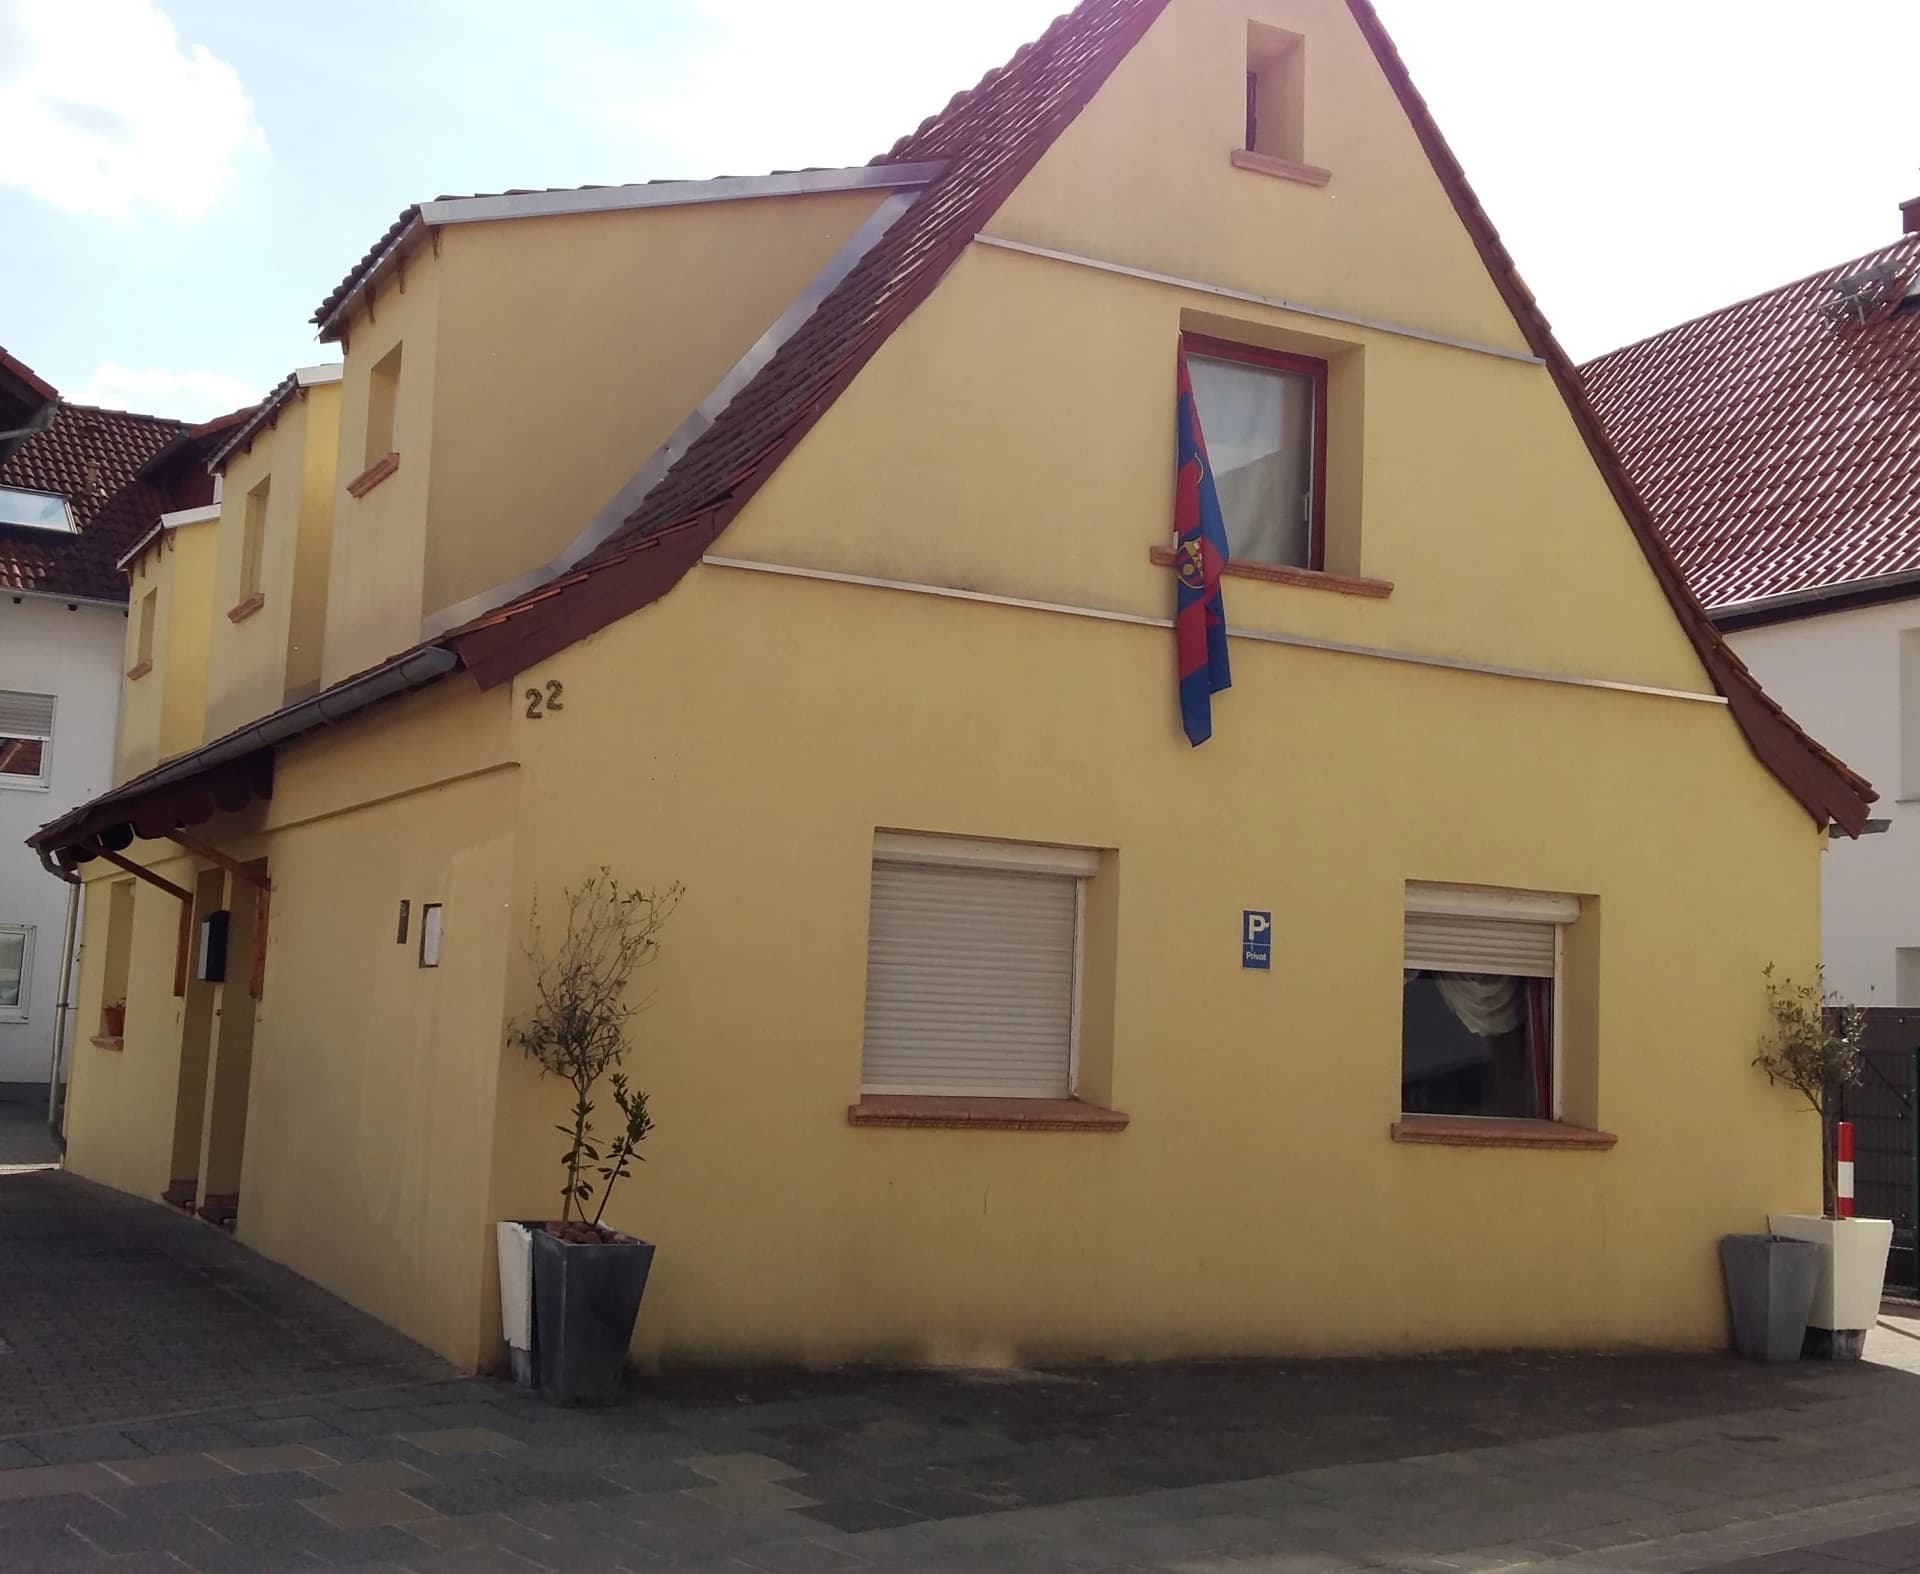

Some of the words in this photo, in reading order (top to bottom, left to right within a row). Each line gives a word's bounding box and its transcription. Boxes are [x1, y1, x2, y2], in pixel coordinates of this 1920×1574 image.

[526, 680, 563, 719] 22
[1248, 914, 1266, 940] P
[1246, 951, 1267, 961] Privat
